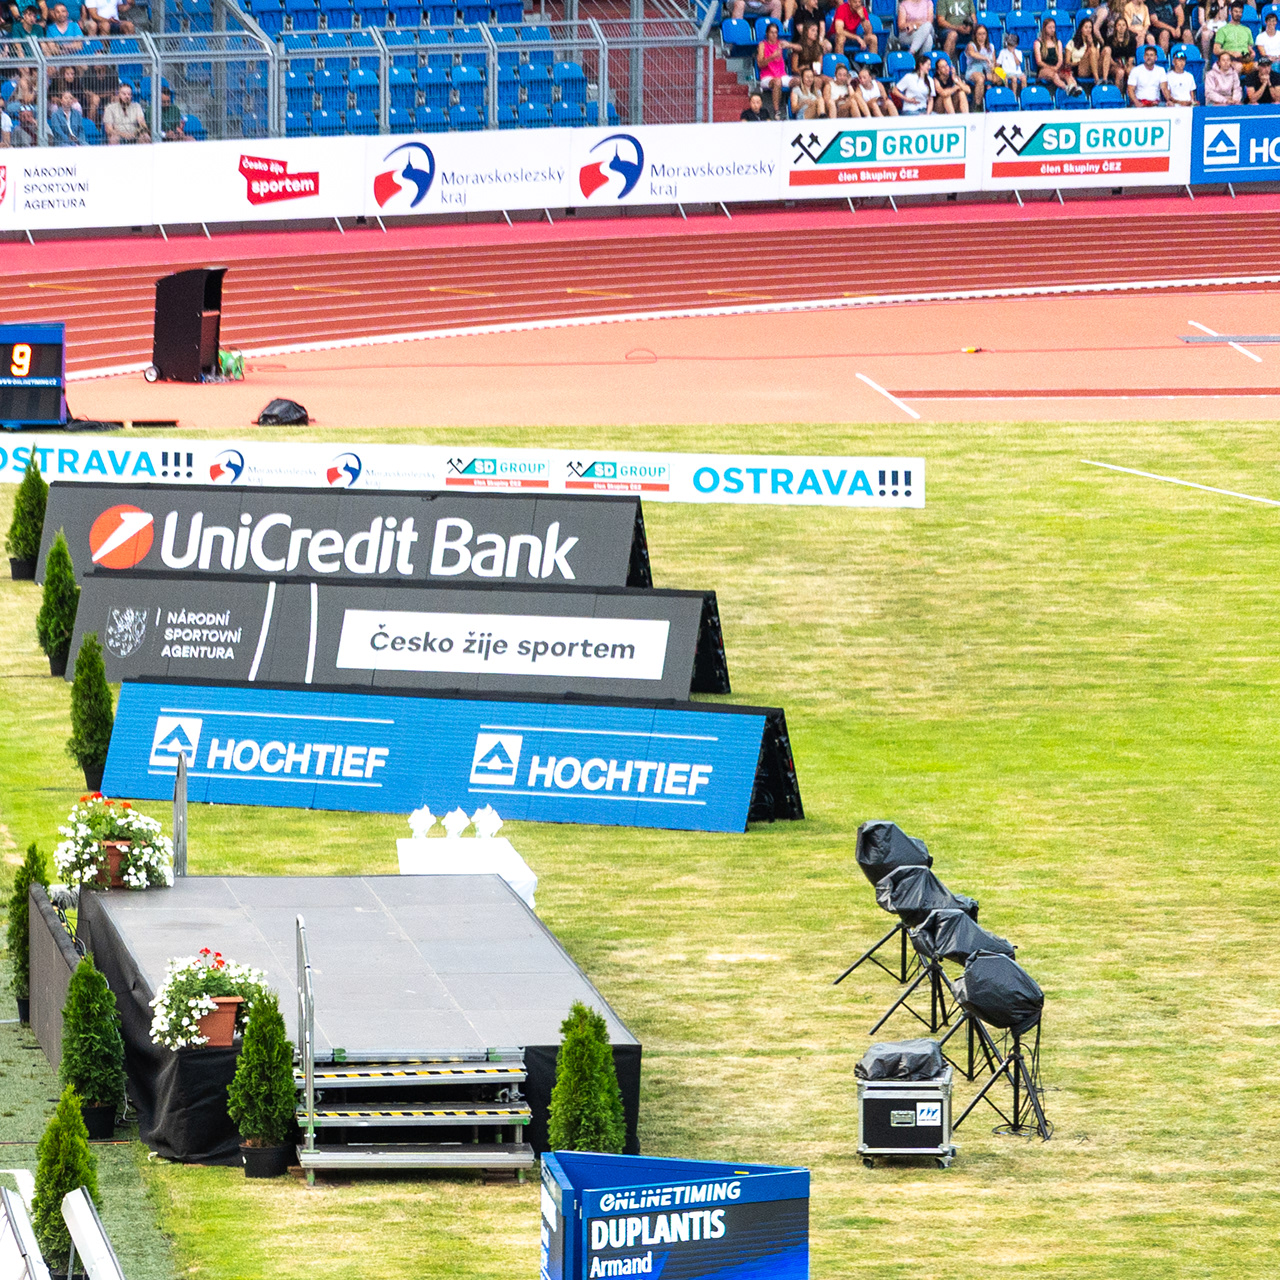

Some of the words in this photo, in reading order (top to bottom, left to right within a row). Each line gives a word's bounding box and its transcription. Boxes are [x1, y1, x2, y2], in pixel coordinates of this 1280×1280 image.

[840, 136, 872, 158] SD
[883, 133, 959, 155] GROUP
[1043, 129, 1076, 150] SD
[1086, 127, 1164, 148] GROUP
[23, 163, 78, 179] NÁRODNÍ
[441, 168, 565, 187] Moravskoslezský
[650, 161, 776, 181] Moravskoslezský
[23, 179, 89, 196] SPORTOVNÍ
[251, 178, 314, 197] sportem
[650, 182, 677, 198] kraj
[23, 197, 86, 211] AGENTURA
[441, 189, 467, 206] kraj
[11, 343, 32, 377] 9
[474, 459, 496, 474] SD
[500, 462, 546, 474] GROUP
[594, 463, 616, 477] SD
[620, 465, 666, 478] GROUP
[693, 466, 913, 497] OSTRAVA!!!
[159, 509, 420, 577] UniCredit
[432, 516, 580, 581] Bank
[167, 608, 231, 626] NÁRODNÍ
[164, 625, 242, 644] SPORTOVNÍ
[161, 645, 235, 661] AGENTURA
[369, 624, 455, 656] Česko
[462, 629, 508, 661] žije
[517, 635, 636, 666] sportem
[206, 738, 390, 779] HOCHTIEF
[528, 755, 714, 796] HOCHTIEF
[591, 1208, 726, 1251] DUPLANTIS
[590, 1250, 653, 1278] Armand
